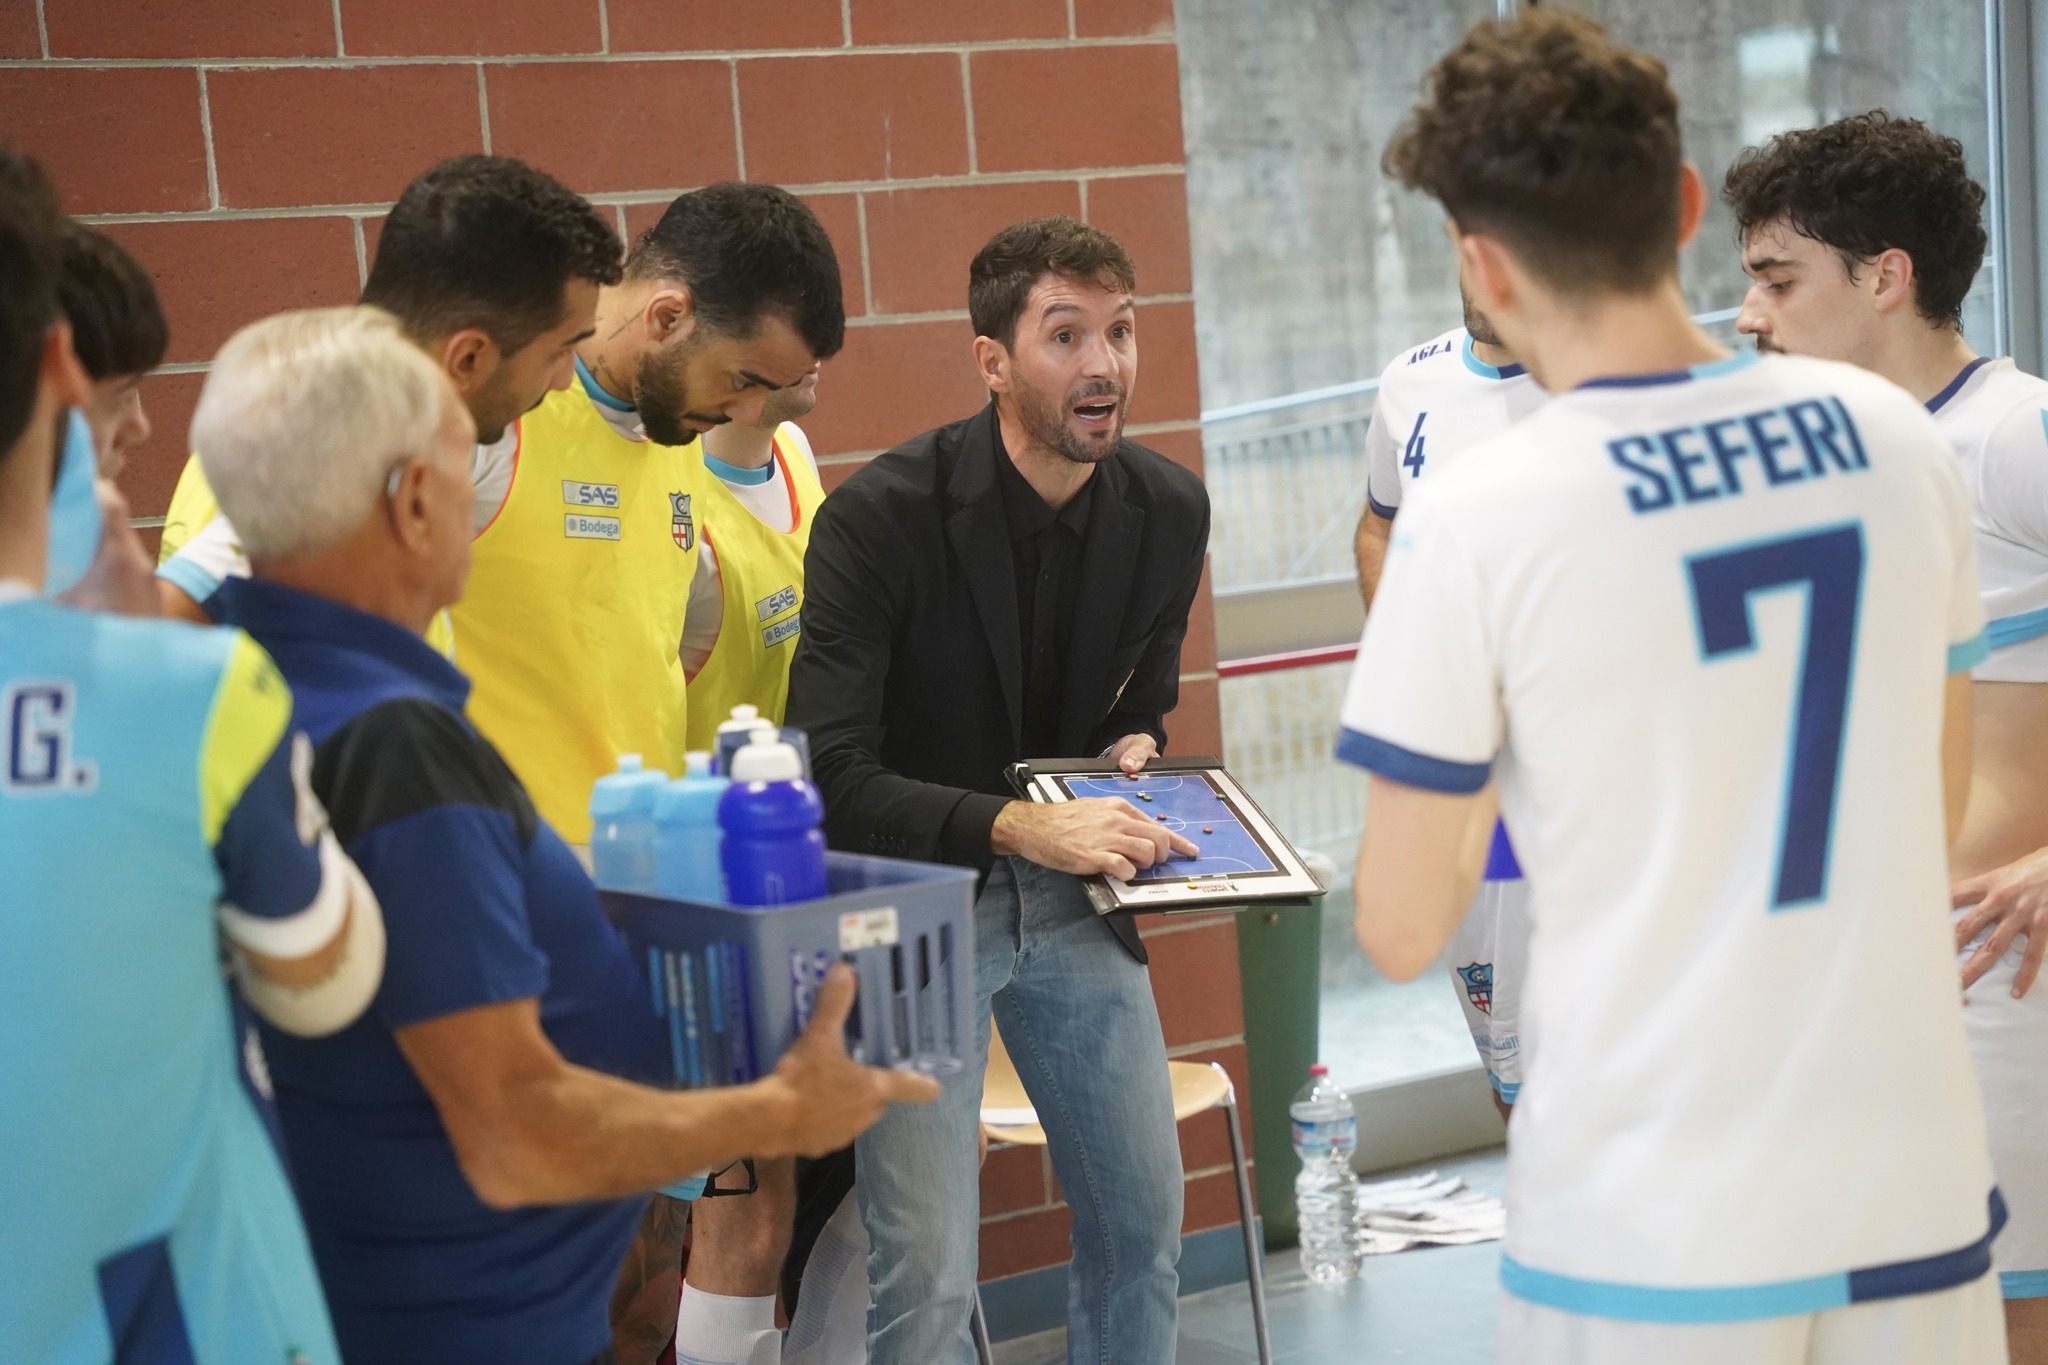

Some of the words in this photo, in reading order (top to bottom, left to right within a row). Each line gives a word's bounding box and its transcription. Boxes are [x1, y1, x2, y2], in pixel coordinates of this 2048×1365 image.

[1402, 410, 1429, 479] 4
[1607, 395, 1871, 516] SEFERI
[579, 485, 618, 506] SAS
[579, 519, 619, 537] Bodega
[769, 588, 796, 615] SAS
[774, 618, 801, 639] Bodeg
[5, 679, 98, 794] G.
[1682, 519, 1868, 912] 7
